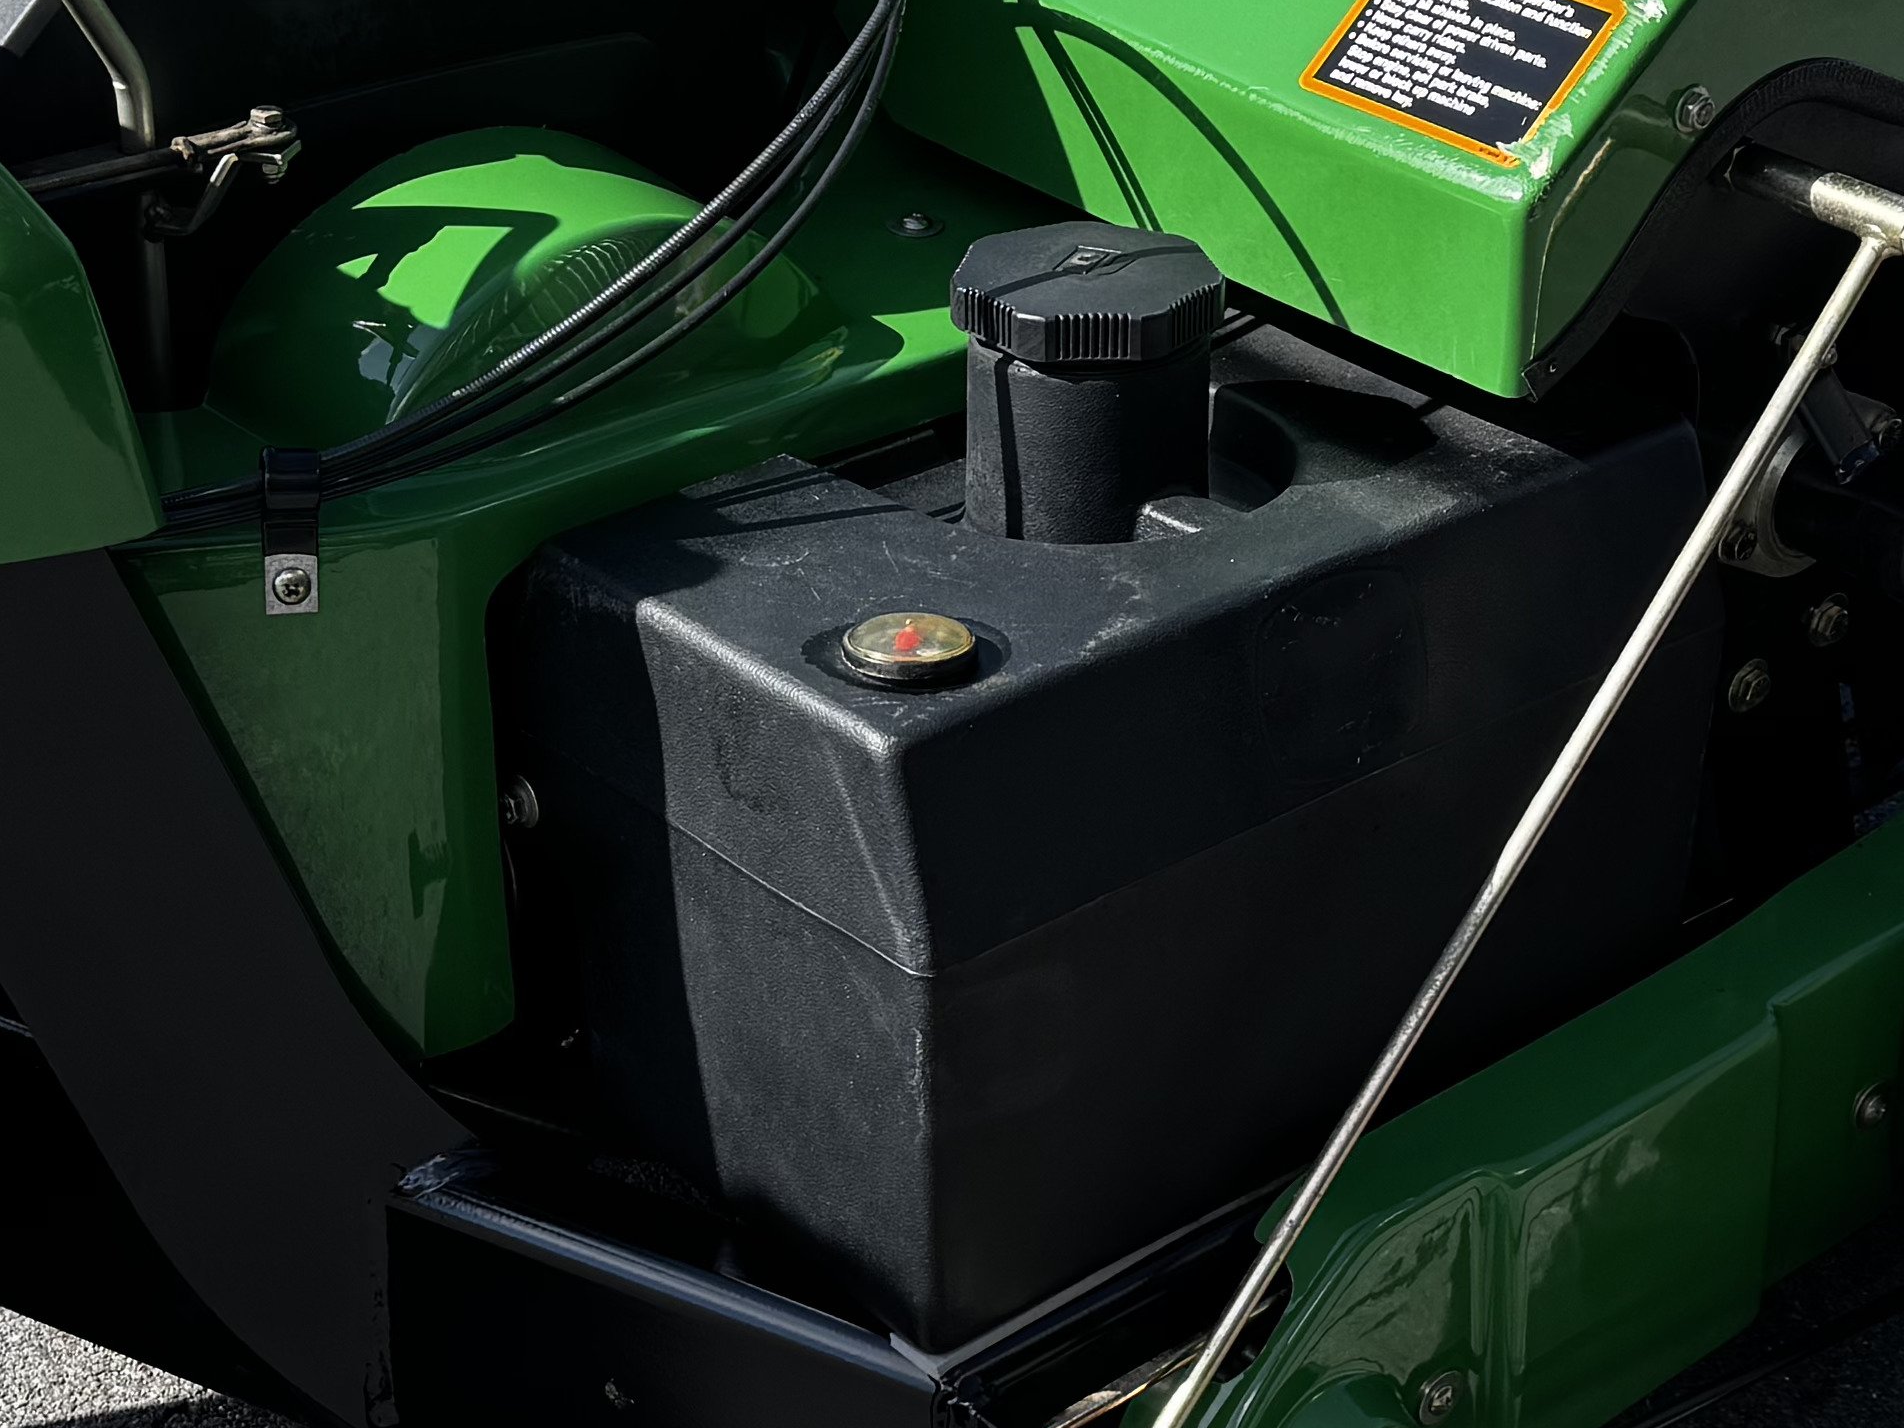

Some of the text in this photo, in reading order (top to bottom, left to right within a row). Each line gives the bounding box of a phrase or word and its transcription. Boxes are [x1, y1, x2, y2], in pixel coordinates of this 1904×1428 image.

[1371, 12, 1466, 54] Never carry riders.
[1378, 0, 1547, 68] Stay clear of power driven parts.
[1416, 0, 1434, 11] all
[1431, 4, 1471, 25] shields
[1470, 16, 1484, 30] in
[1481, 23, 1515, 42] place.
[1521, 7, 1547, 22] and
[1544, 14, 1592, 38] function
[1363, 22, 1457, 65] Keep others away.
[1329, 69, 1413, 108] and remove key.
[1338, 57, 1475, 115] lower or block up machine
[1347, 45, 1489, 108] Stop engine, set park brake,
[1355, 34, 1542, 110] Before servicing or leaving machine:
